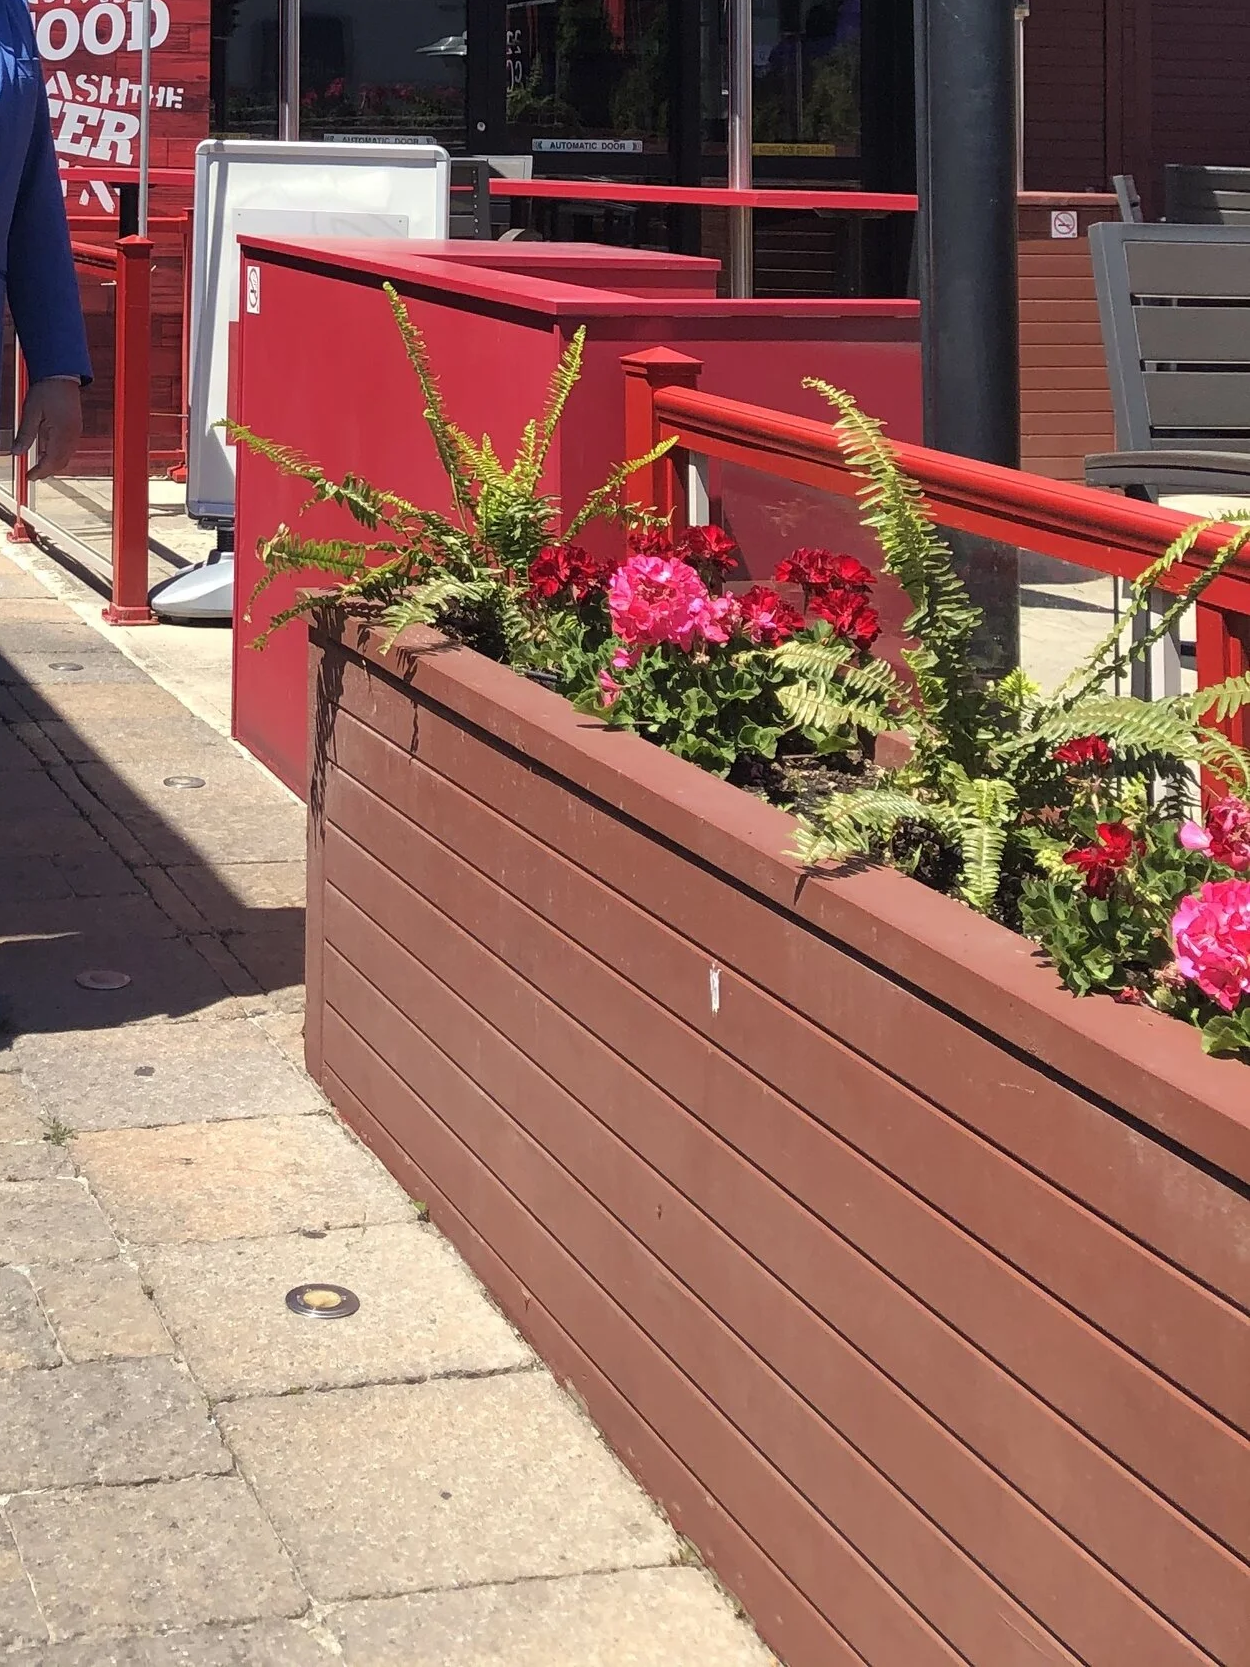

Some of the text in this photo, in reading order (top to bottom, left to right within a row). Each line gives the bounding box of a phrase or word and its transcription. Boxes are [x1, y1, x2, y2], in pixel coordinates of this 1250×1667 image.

[129, 83, 184, 109] THE
[550, 141, 626, 151] AUTOMATIC DOOR
